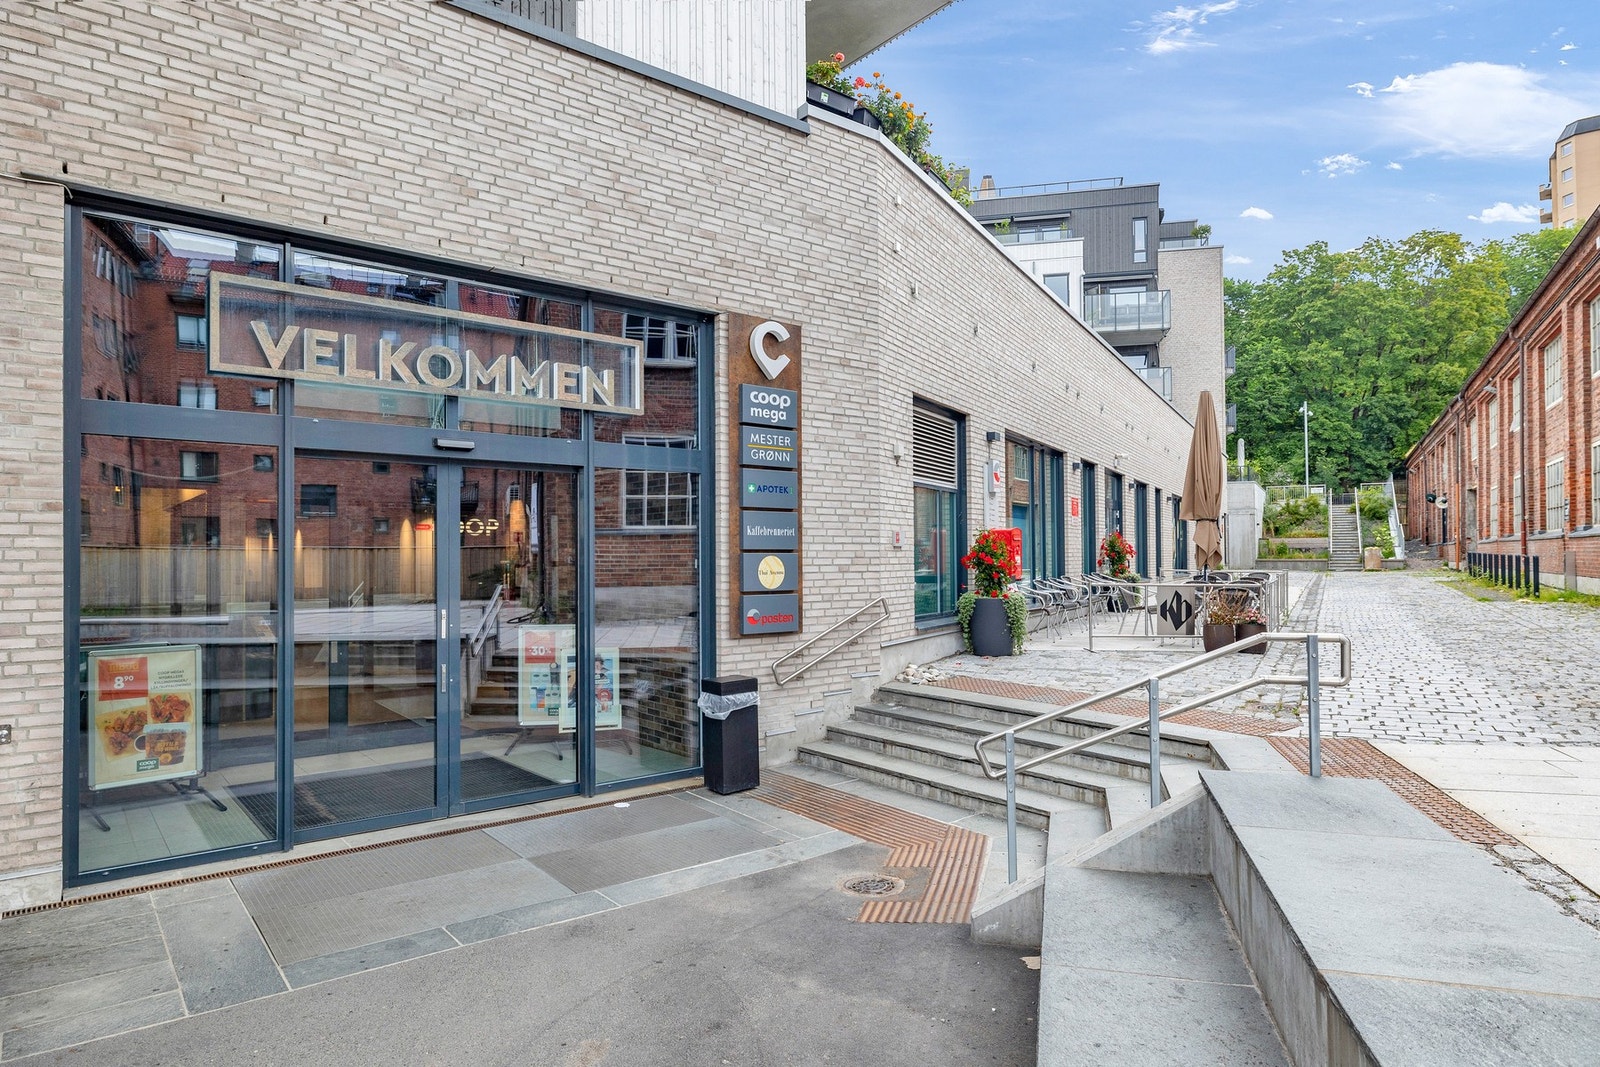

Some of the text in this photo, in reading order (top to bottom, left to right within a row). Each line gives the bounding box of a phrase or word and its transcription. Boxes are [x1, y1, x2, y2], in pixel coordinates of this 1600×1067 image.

[251, 320, 615, 406] VELKOMMEN
[749, 391, 791, 409] coop
[750, 407, 787, 423] mega
[750, 433, 791, 446] MESTER
[750, 449, 790, 462] GRØNN
[756, 484, 789, 494] APOTEK
[746, 525, 795, 537] Kaffebrenneriet
[760, 612, 794, 626] posten
